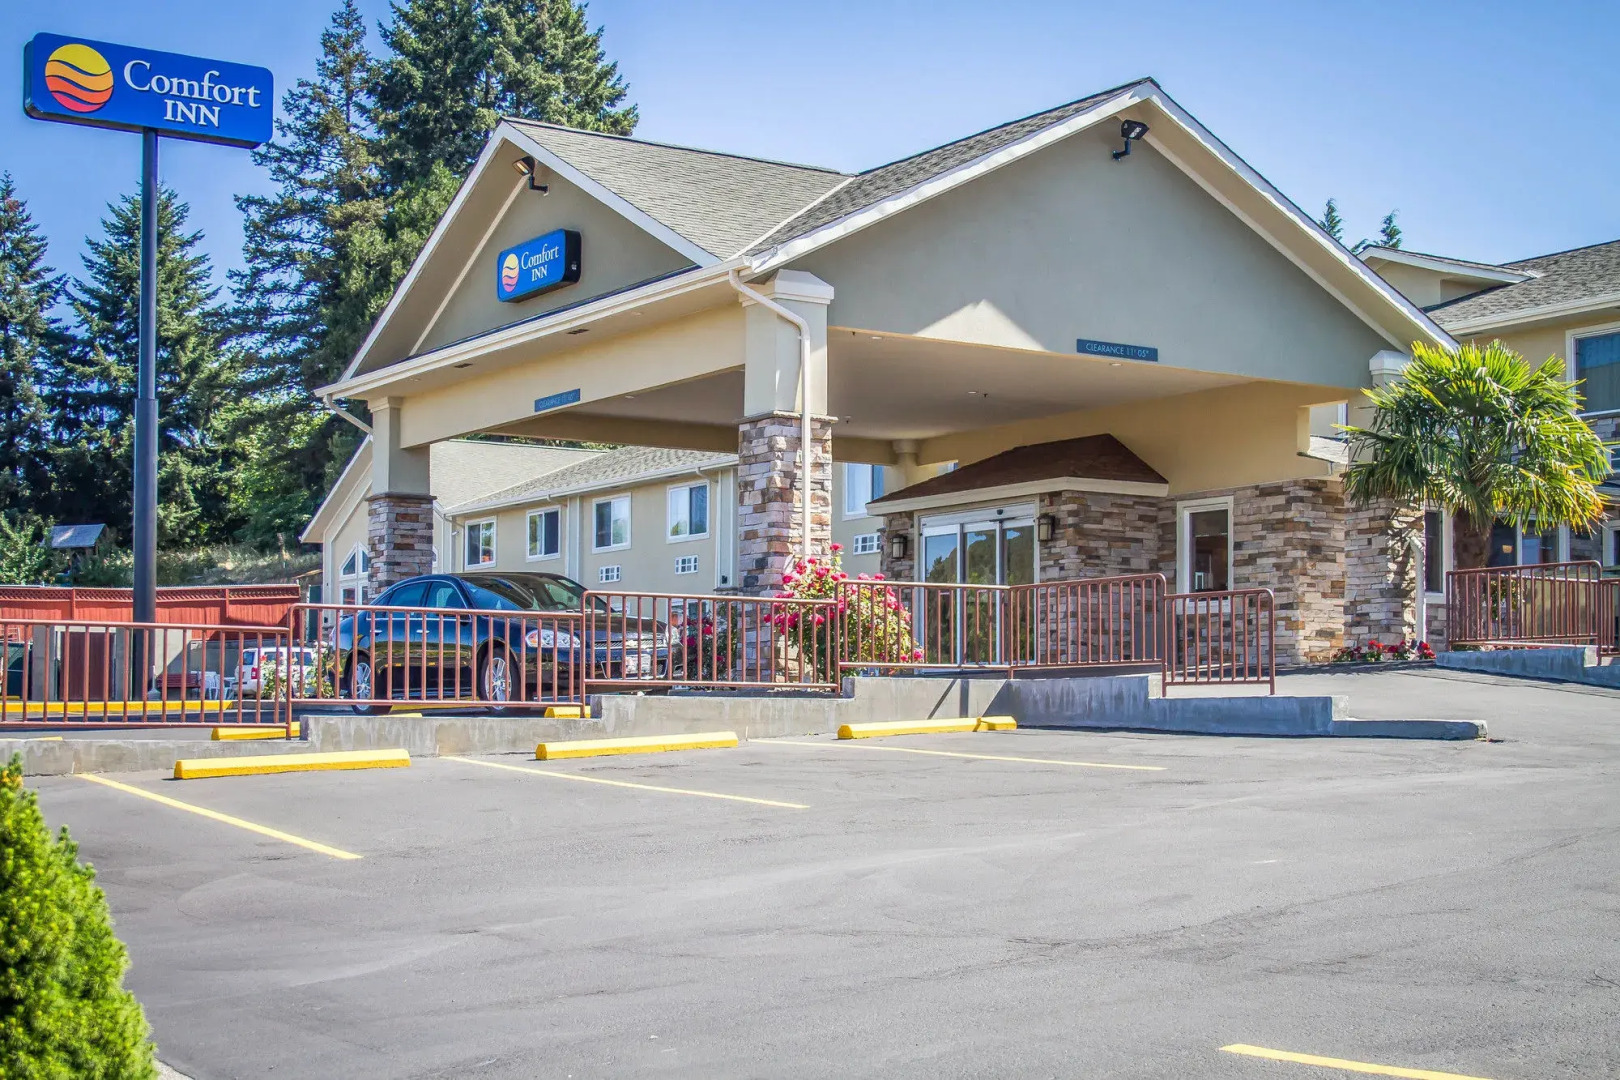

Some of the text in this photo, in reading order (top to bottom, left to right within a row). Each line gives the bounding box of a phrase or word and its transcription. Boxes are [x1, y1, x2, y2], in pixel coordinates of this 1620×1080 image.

[123, 60, 261, 108] Comfort
[163, 99, 220, 127] INN
[521, 243, 559, 270] Comfort
[531, 264, 548, 282] INN
[1085, 342, 1124, 355] CLEARANCE
